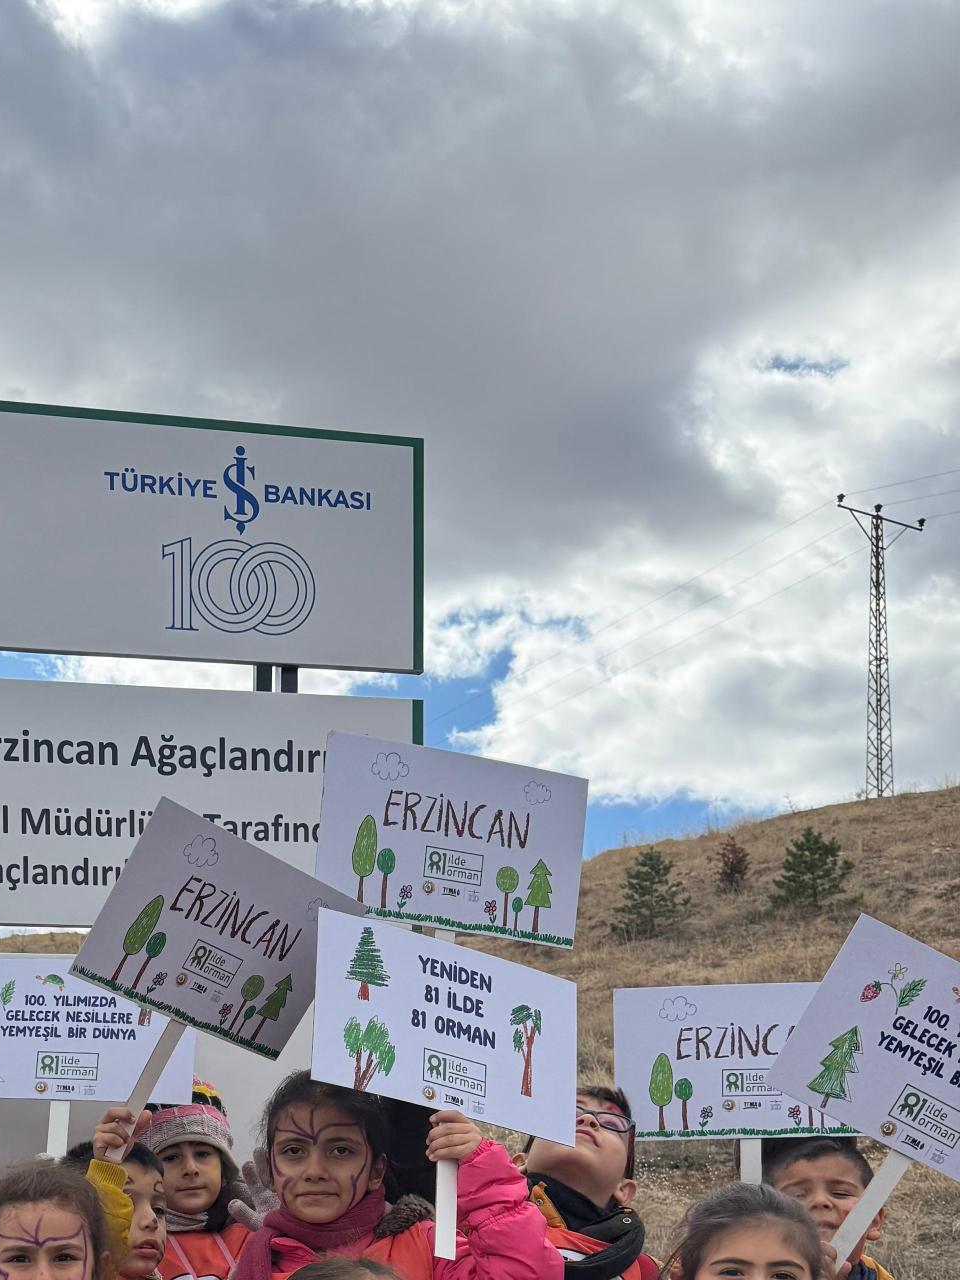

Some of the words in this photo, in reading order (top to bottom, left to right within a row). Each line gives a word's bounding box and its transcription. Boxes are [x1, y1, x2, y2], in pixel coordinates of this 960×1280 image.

[104, 467, 217, 499] TÜRKİYE
[264, 484, 372, 511] BANKASI
[161, 536, 316, 636] 100
[130, 734, 326, 777] Ağaçlandır
[382, 788, 530, 849] ERZİNCAN
[428, 850, 447, 877] 81
[447, 852, 466, 867] ilde
[446, 867, 480, 882] orman
[169, 874, 302, 961] ERZİNCAN
[189, 945, 212, 972] 81
[208, 949, 227, 968] ilde
[203, 965, 231, 983] orman
[418, 954, 493, 993] YENİDEN
[24, 994, 47, 1007] 100.
[53, 994, 117, 1008] YILIMIZDA
[424, 984, 440, 1005] 81
[447, 986, 484, 1018] İLDE
[6, 1009, 60, 1023] GELECEK
[66, 1008, 133, 1025] NESİLLERE
[411, 1008, 427, 1030] 81
[434, 1015, 496, 1050] ORMAN
[923, 1005, 949, 1032] 100.
[0, 1024, 61, 1042] YEMYEŞİL
[67, 1024, 86, 1040] BİR
[92, 1024, 136, 1040] DÜNYA
[892, 1015, 958, 1058] GELECEK
[40, 1054, 59, 1075] 81
[60, 1055, 80, 1066] ilde
[426, 1054, 447, 1082] 81
[447, 1058, 469, 1075] ilde
[878, 1030, 945, 1079] YEMYEŞİL
[60, 1067, 94, 1078] orman
[447, 1075, 483, 1093] orman
[725, 1072, 744, 1092] 81
[745, 1072, 764, 1082] ilde
[897, 1091, 928, 1121] 81
[924, 1100, 948, 1121] ilde
[918, 1117, 957, 1142] orman
